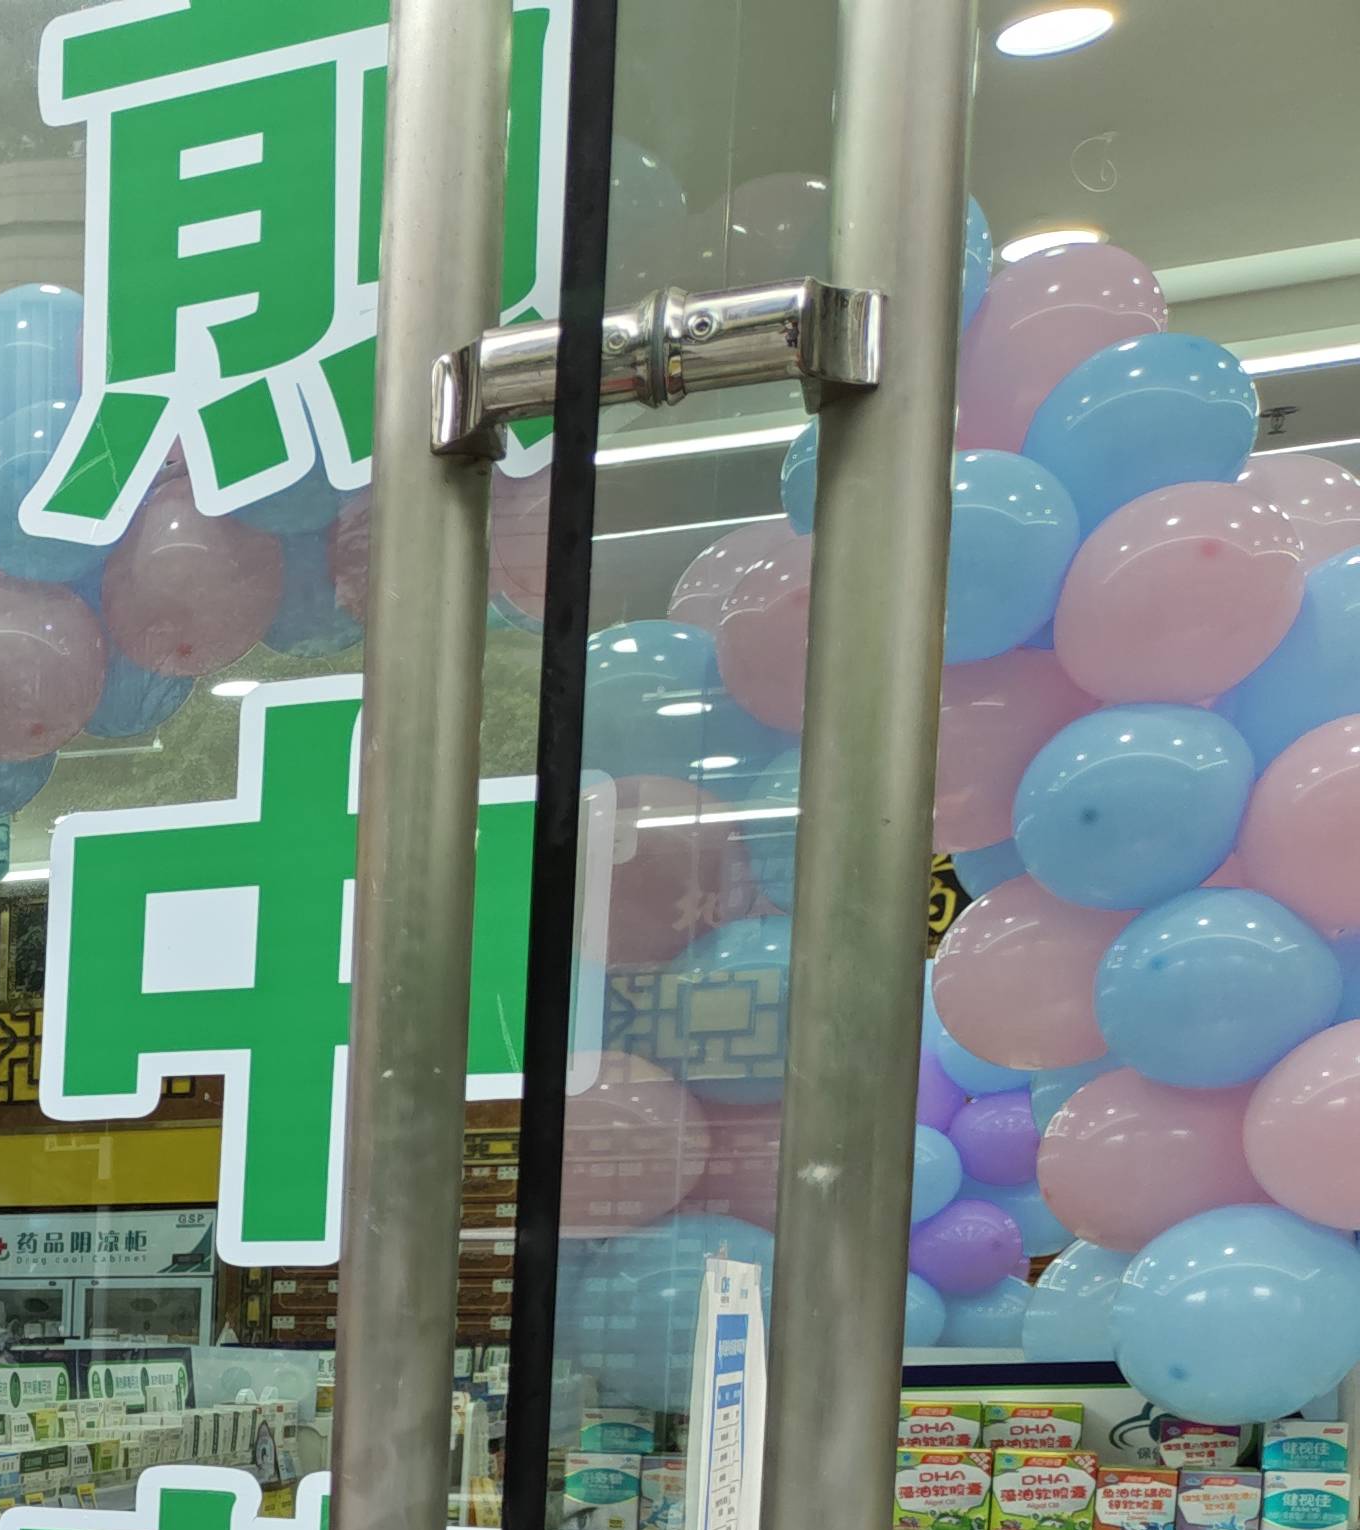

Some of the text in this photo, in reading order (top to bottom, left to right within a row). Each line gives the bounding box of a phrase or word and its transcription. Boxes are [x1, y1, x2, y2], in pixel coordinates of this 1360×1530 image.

[16, 1230, 148, 1254] 药品阴凉柜
[909, 1422, 955, 1434] DHA
[1010, 1423, 1056, 1435] DHA
[919, 1471, 966, 1483] DHA
[1021, 1473, 1071, 1486] DHA
